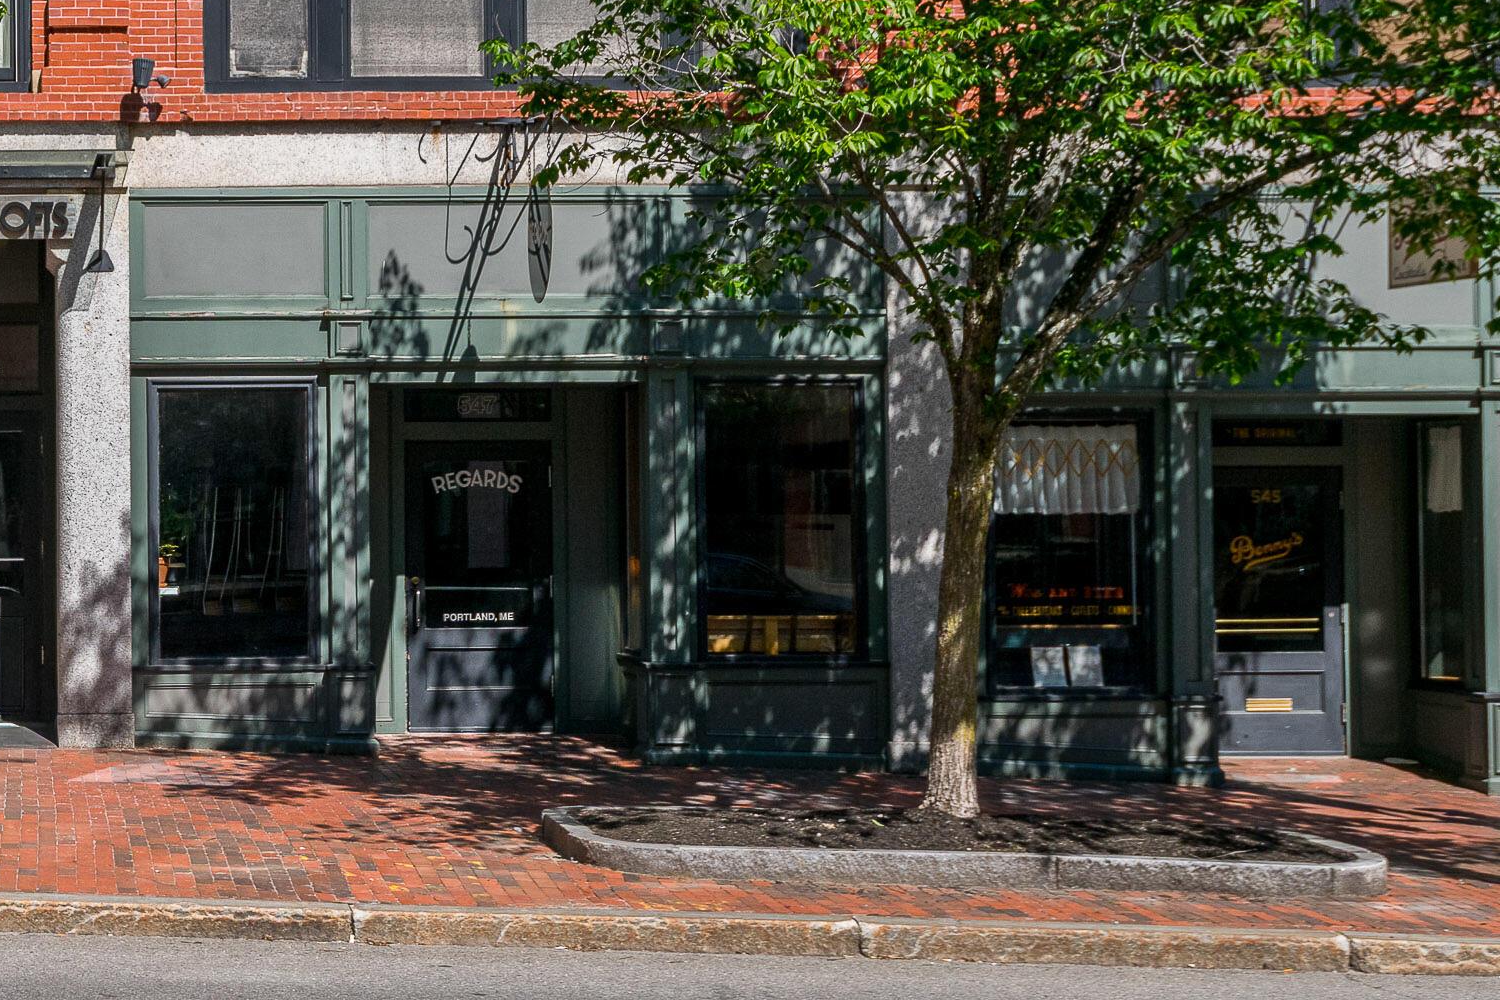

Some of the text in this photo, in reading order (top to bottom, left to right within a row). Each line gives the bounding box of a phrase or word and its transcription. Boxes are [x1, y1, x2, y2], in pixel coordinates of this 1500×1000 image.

[457, 395, 498, 415] 547
[431, 469, 523, 494] REGARDS
[1251, 489, 1281, 504] 545
[443, 612, 514, 622] PORTLAND, ME
